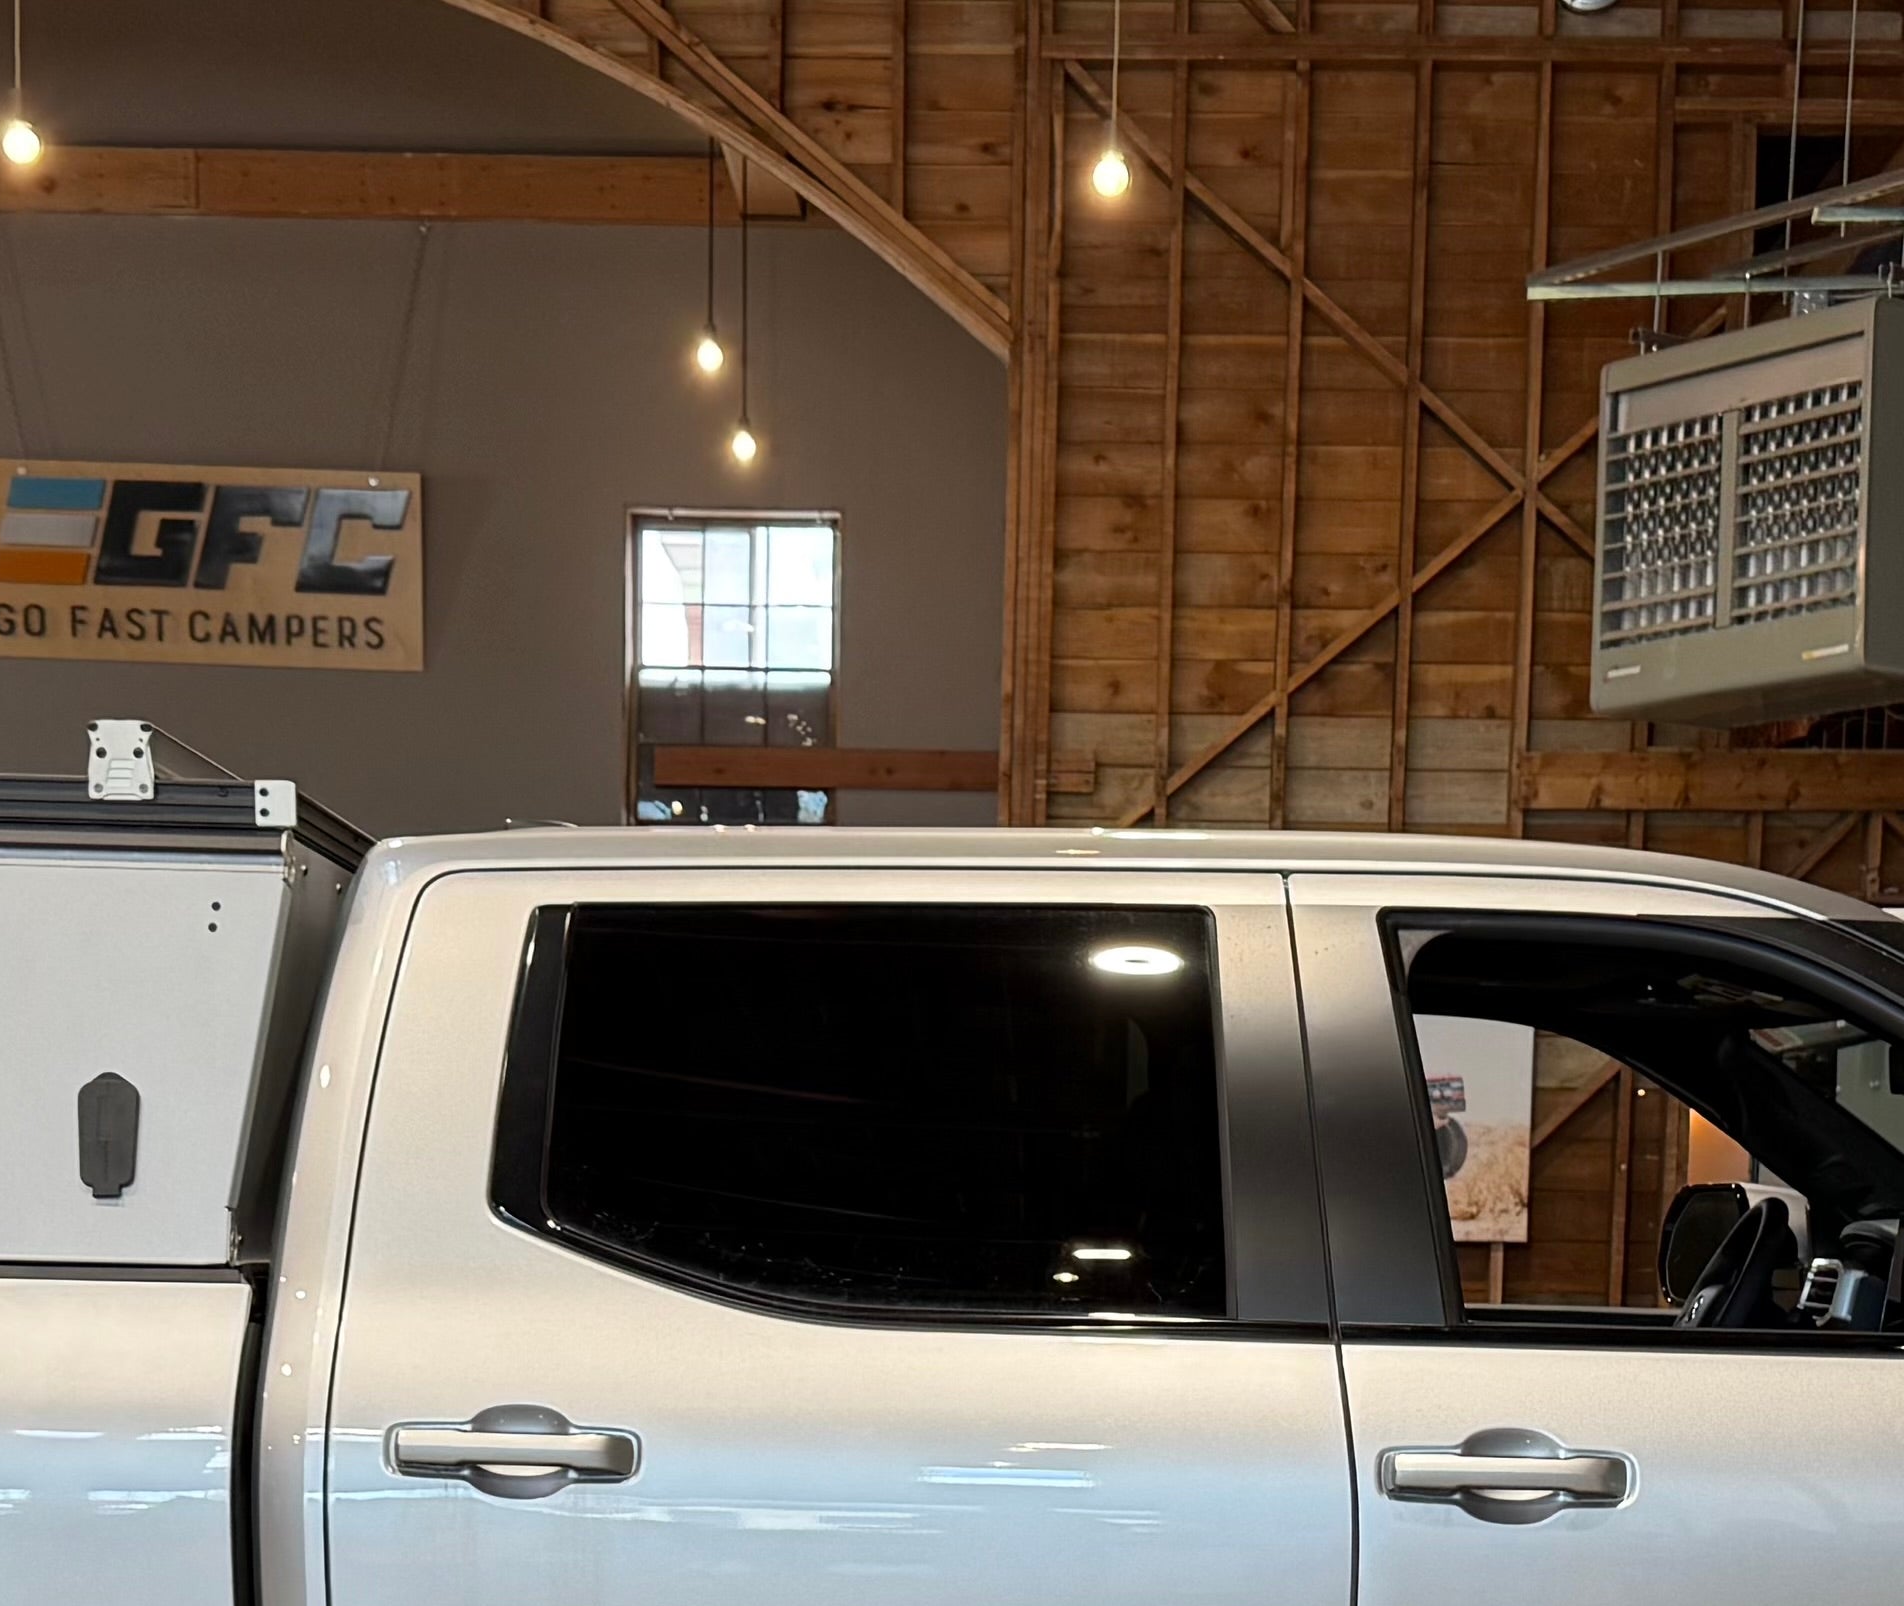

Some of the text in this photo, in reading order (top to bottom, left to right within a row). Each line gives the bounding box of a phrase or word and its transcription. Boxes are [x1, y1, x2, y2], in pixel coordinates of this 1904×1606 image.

[94, 478, 412, 596] GFC
[71, 606, 170, 643] FAST
[188, 609, 386, 651] CAMPERS
